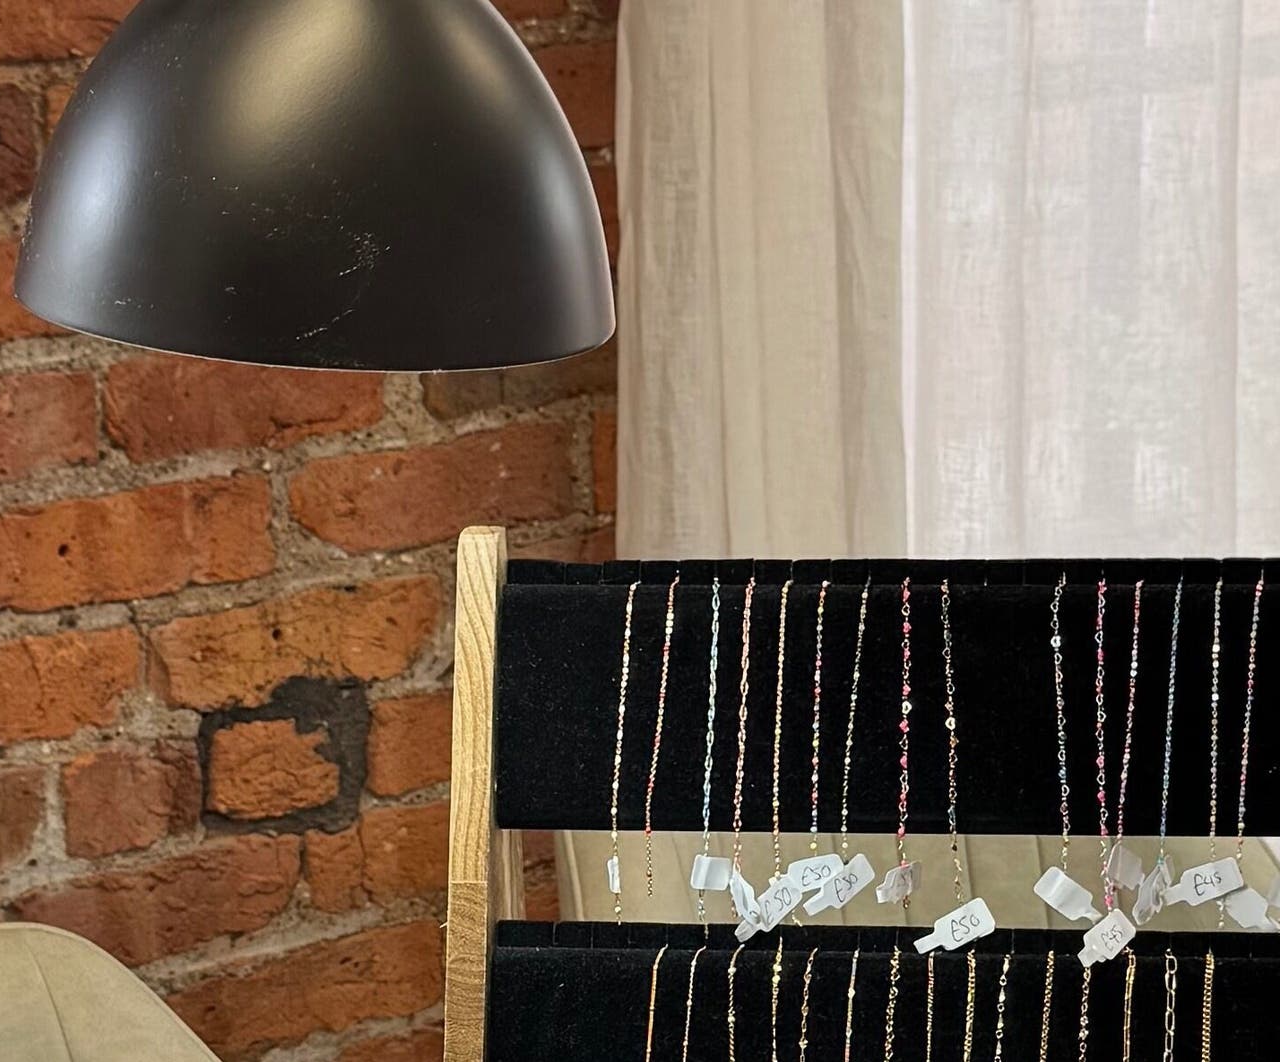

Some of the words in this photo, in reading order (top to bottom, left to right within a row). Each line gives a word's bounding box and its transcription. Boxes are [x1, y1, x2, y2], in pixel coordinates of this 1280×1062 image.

[801, 864, 832, 887] £50
[833, 872, 858, 903] £50
[1192, 870, 1222, 896] £45
[763, 886, 793, 925] £50
[950, 913, 981, 942] £50
